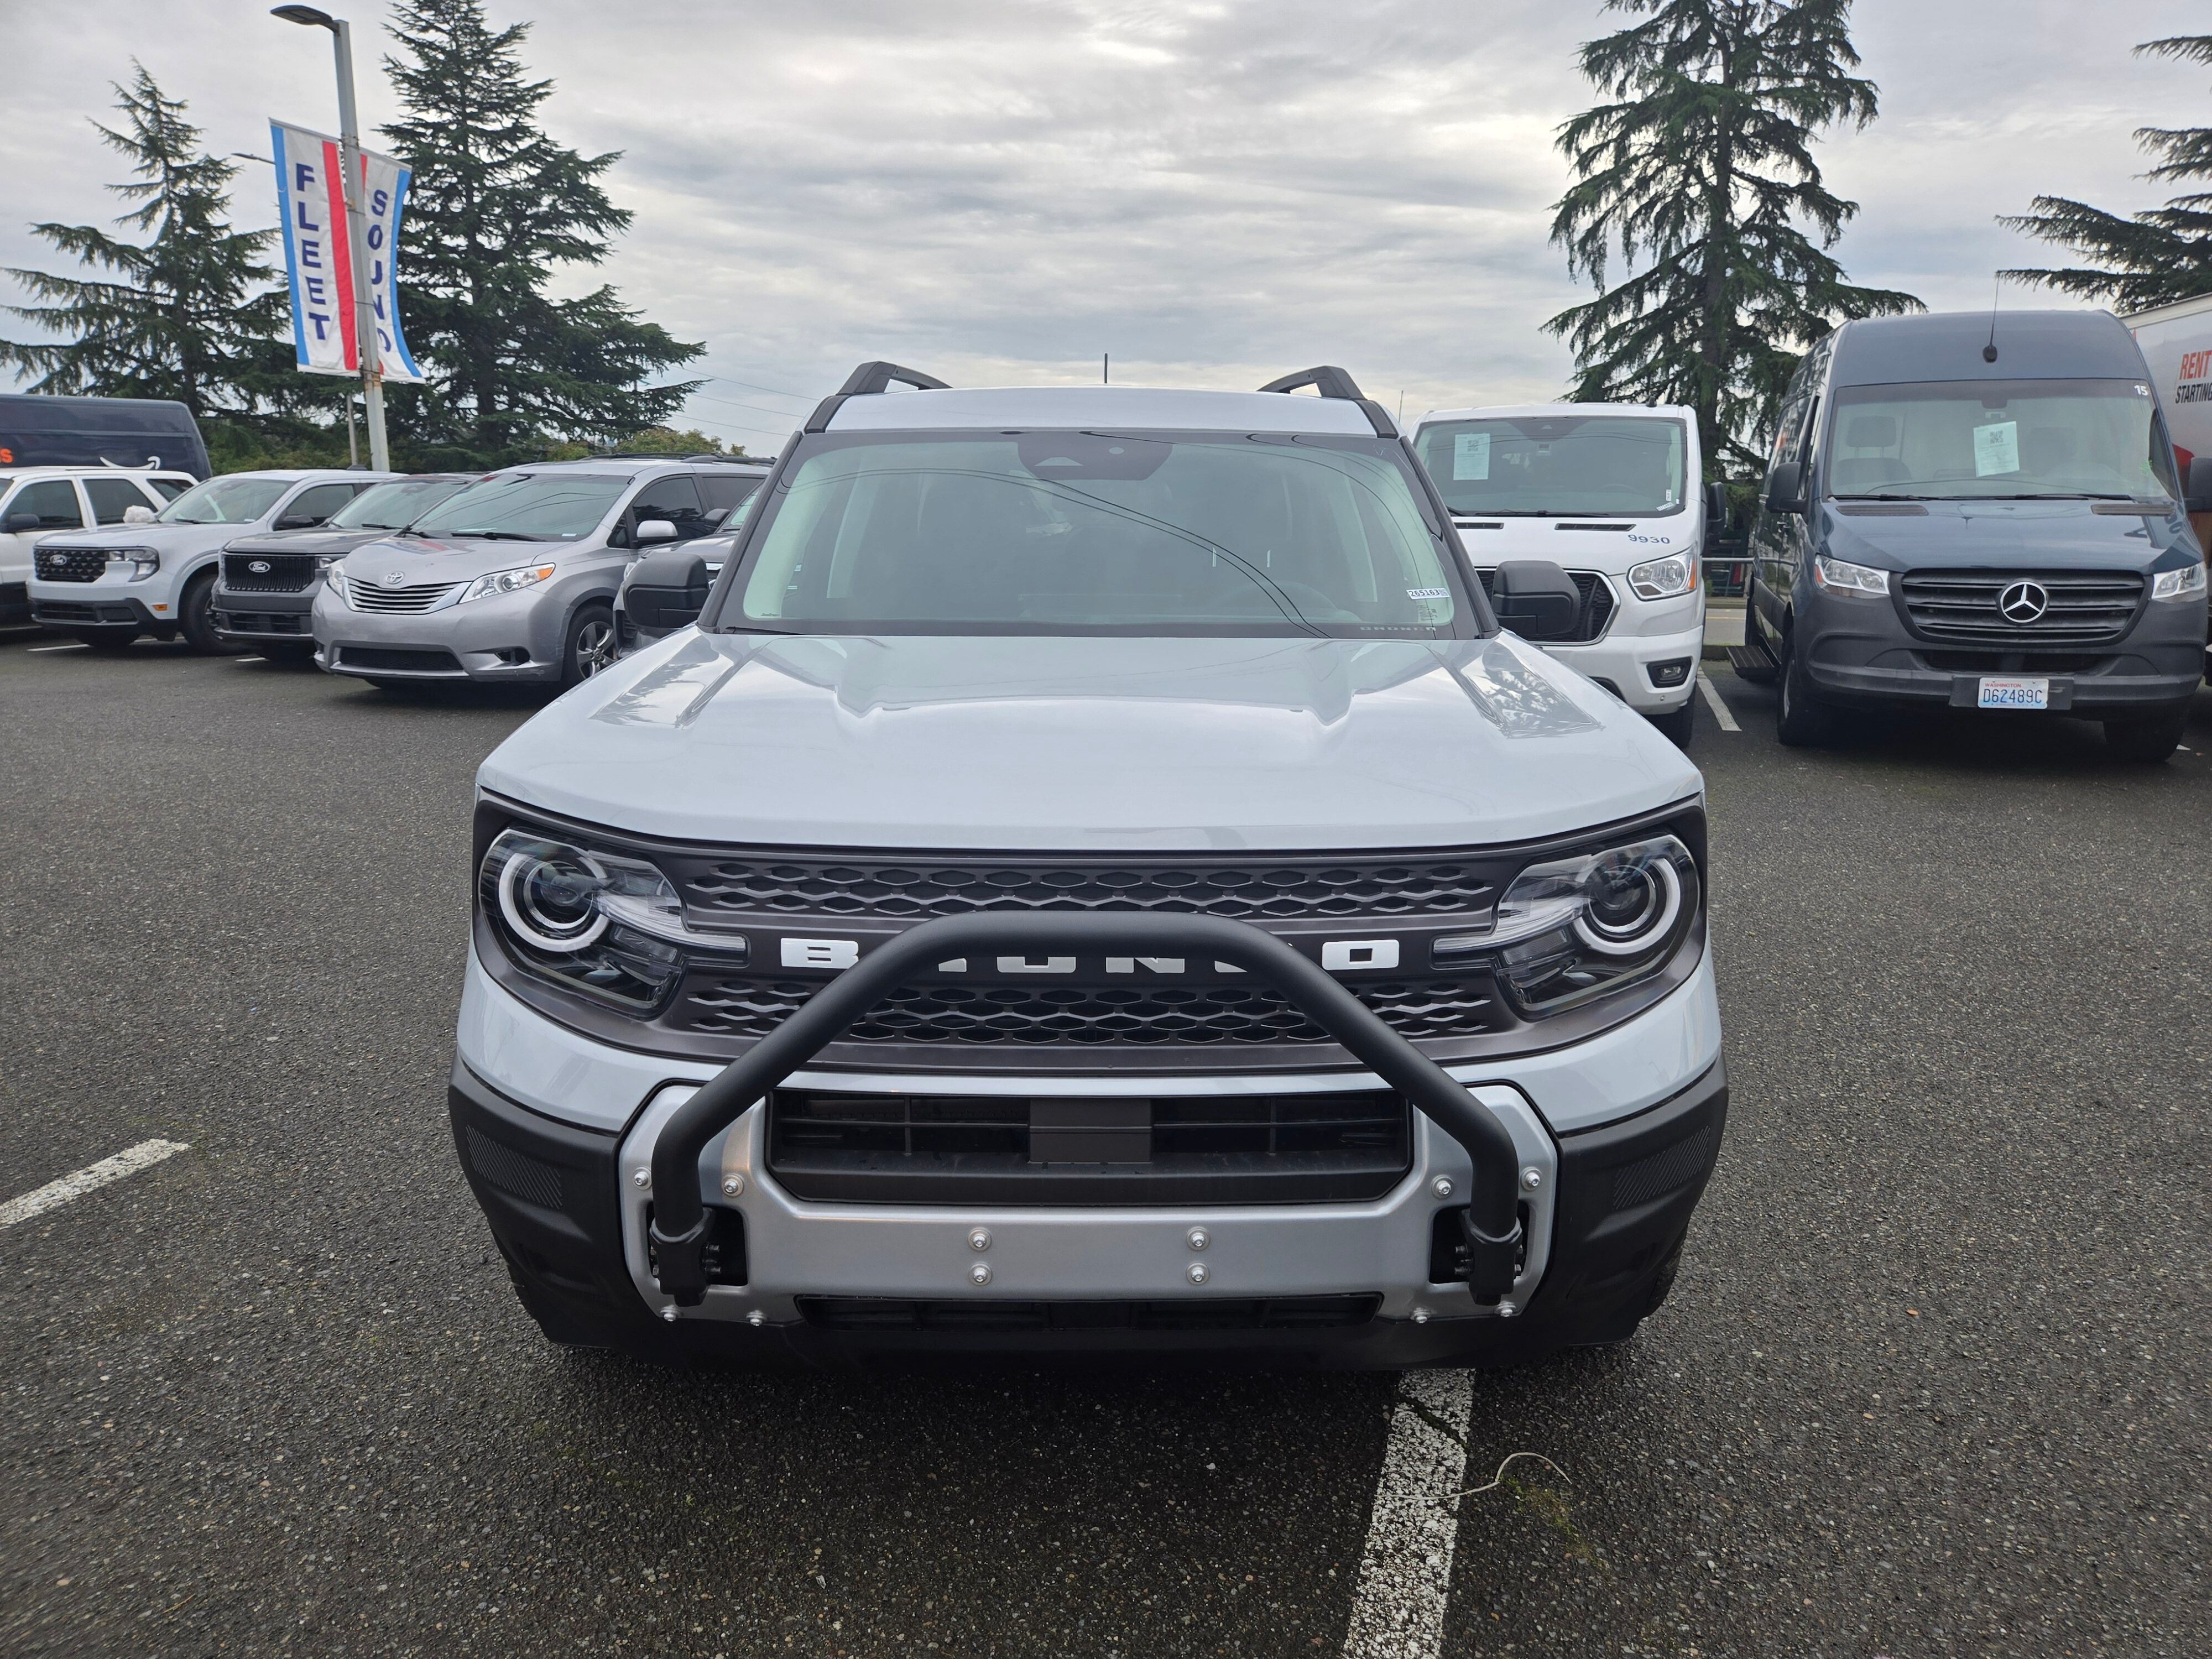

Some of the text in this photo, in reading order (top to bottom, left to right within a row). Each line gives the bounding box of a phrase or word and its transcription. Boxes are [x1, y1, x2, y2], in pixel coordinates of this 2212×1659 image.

[296, 163, 331, 341] FLEET
[2179, 349, 2212, 380] RENT
[2134, 384, 2149, 396] 15
[2175, 383, 2212, 404] STARTING
[1627, 534, 1671, 544] 9930
[1983, 688, 2042, 704] D62489C
